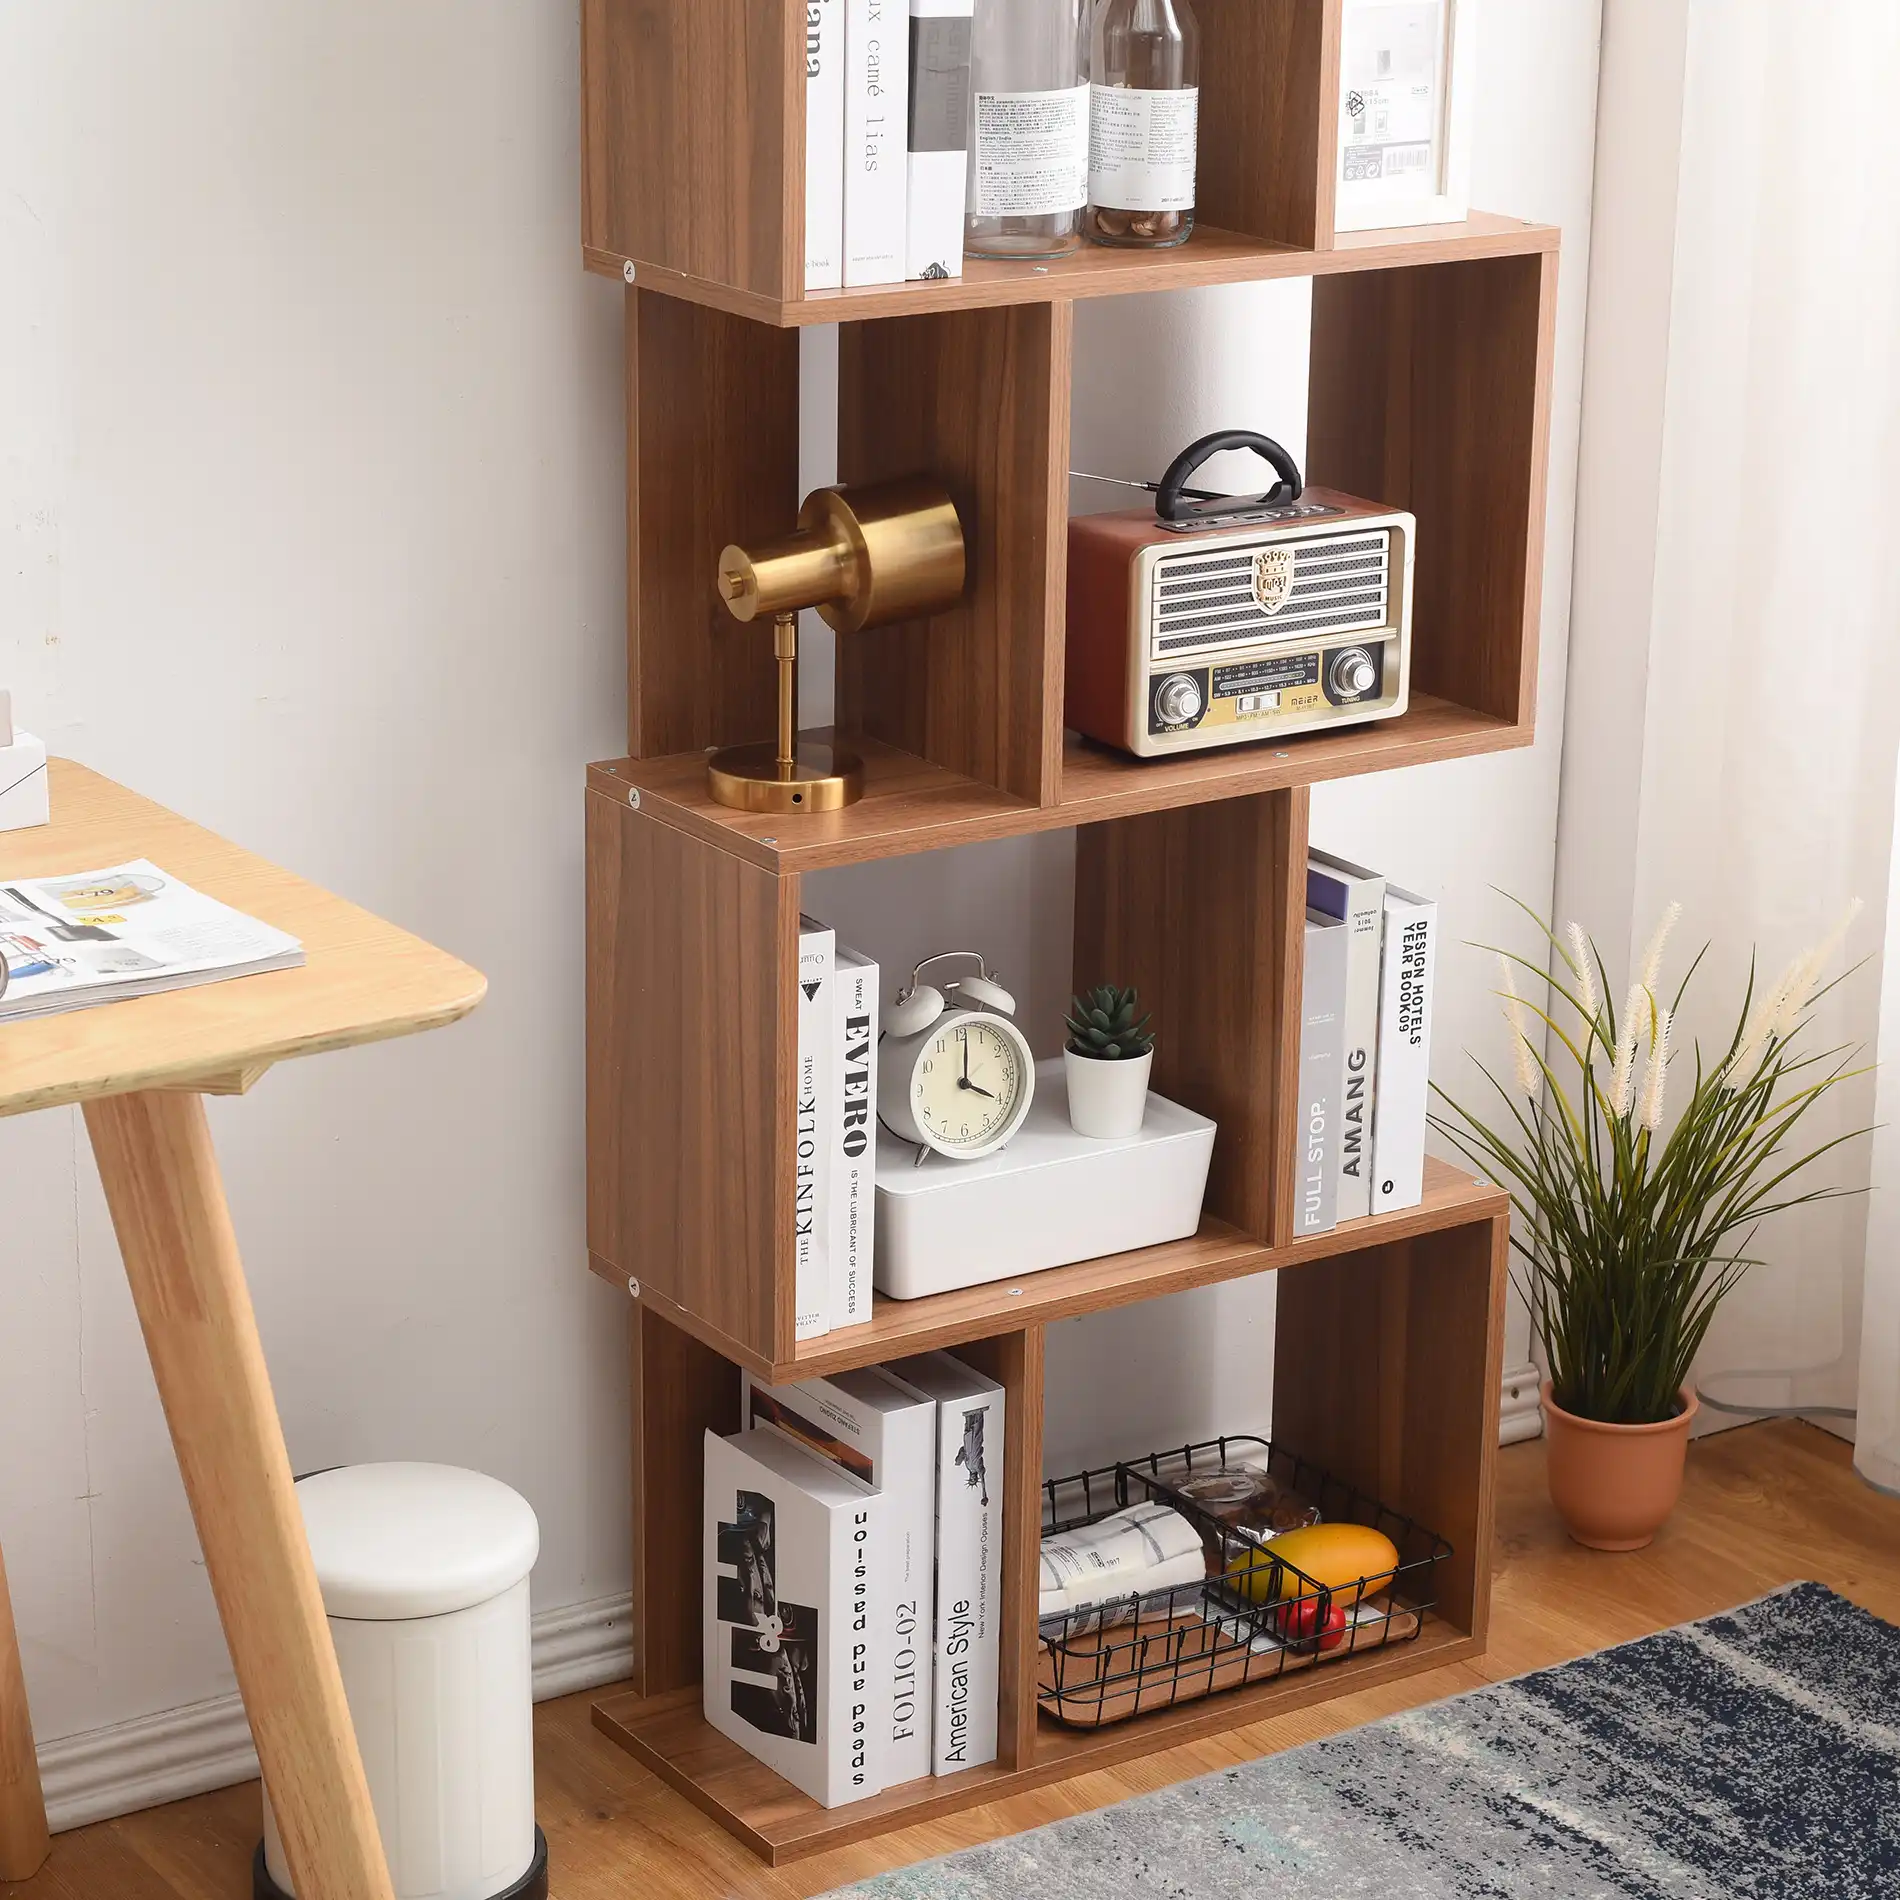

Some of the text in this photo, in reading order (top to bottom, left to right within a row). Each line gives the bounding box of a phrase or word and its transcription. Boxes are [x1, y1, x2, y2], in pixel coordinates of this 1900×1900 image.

[1341, 695, 1361, 704] TUNING
[1164, 722, 1189, 732] VOLUME
[1398, 923, 1415, 1032] YEAR BOOK09
[1410, 921, 1428, 1045] DESIGN HOTELS
[955, 1028, 967, 1042] 12
[979, 1032, 984, 1044] 1
[936, 1040, 946, 1053] 11
[994, 1046, 1002, 1058] 2
[922, 1060, 933, 1074] 10
[1002, 1068, 1009, 1081] 3
[916, 1084, 924, 1097] 9
[995, 1092, 1003, 1105] 4
[923, 1107, 932, 1119] 8
[1343, 1049, 1366, 1177] AMANG
[941, 1120, 948, 1134] 7
[982, 1114, 990, 1127] 5
[961, 1124, 969, 1137] 6
[843, 978, 870, 1314] SWEAT EVERO IS THE LUBRICANT OF SUCCESS
[796, 1055, 815, 1265] THE KINFOLK HOME
[1305, 1098, 1326, 1226] FULL STOP.
[980, 1512, 989, 1542] Opuses
[980, 1544, 989, 1571] Design
[979, 1572, 987, 1599] Interior
[978, 1600, 986, 1622] York
[852, 1511, 868, 1785] speed and passion
[944, 1600, 975, 1763] American Style
